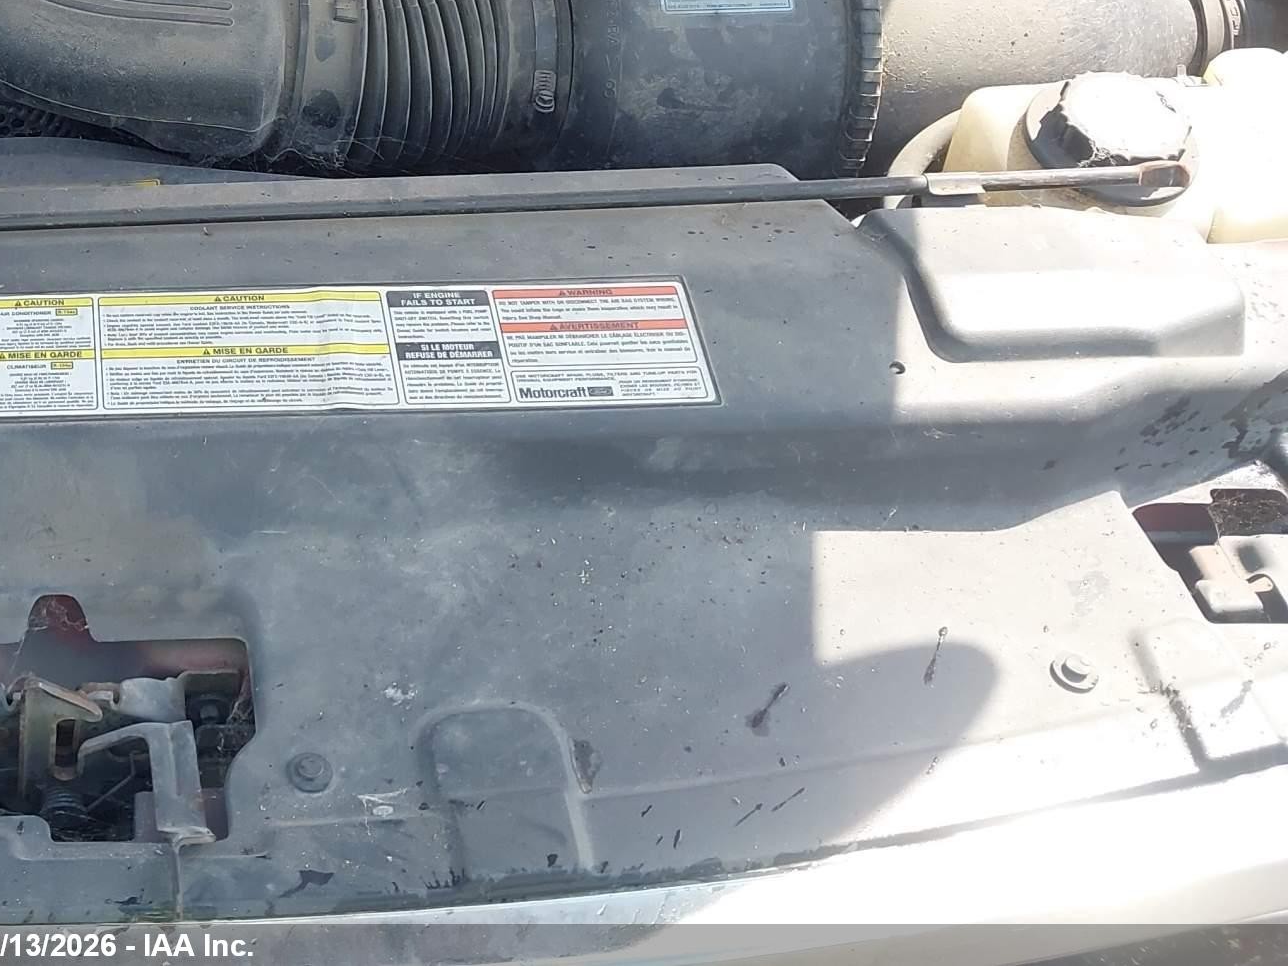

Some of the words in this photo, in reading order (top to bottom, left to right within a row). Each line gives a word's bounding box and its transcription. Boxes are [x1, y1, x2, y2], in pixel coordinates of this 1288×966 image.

[222, 294, 265, 302] CAUTION
[560, 322, 639, 330] AVERTISSEMENT
[255, 346, 288, 354] GARDE
[519, 387, 587, 399] Motorcraft
